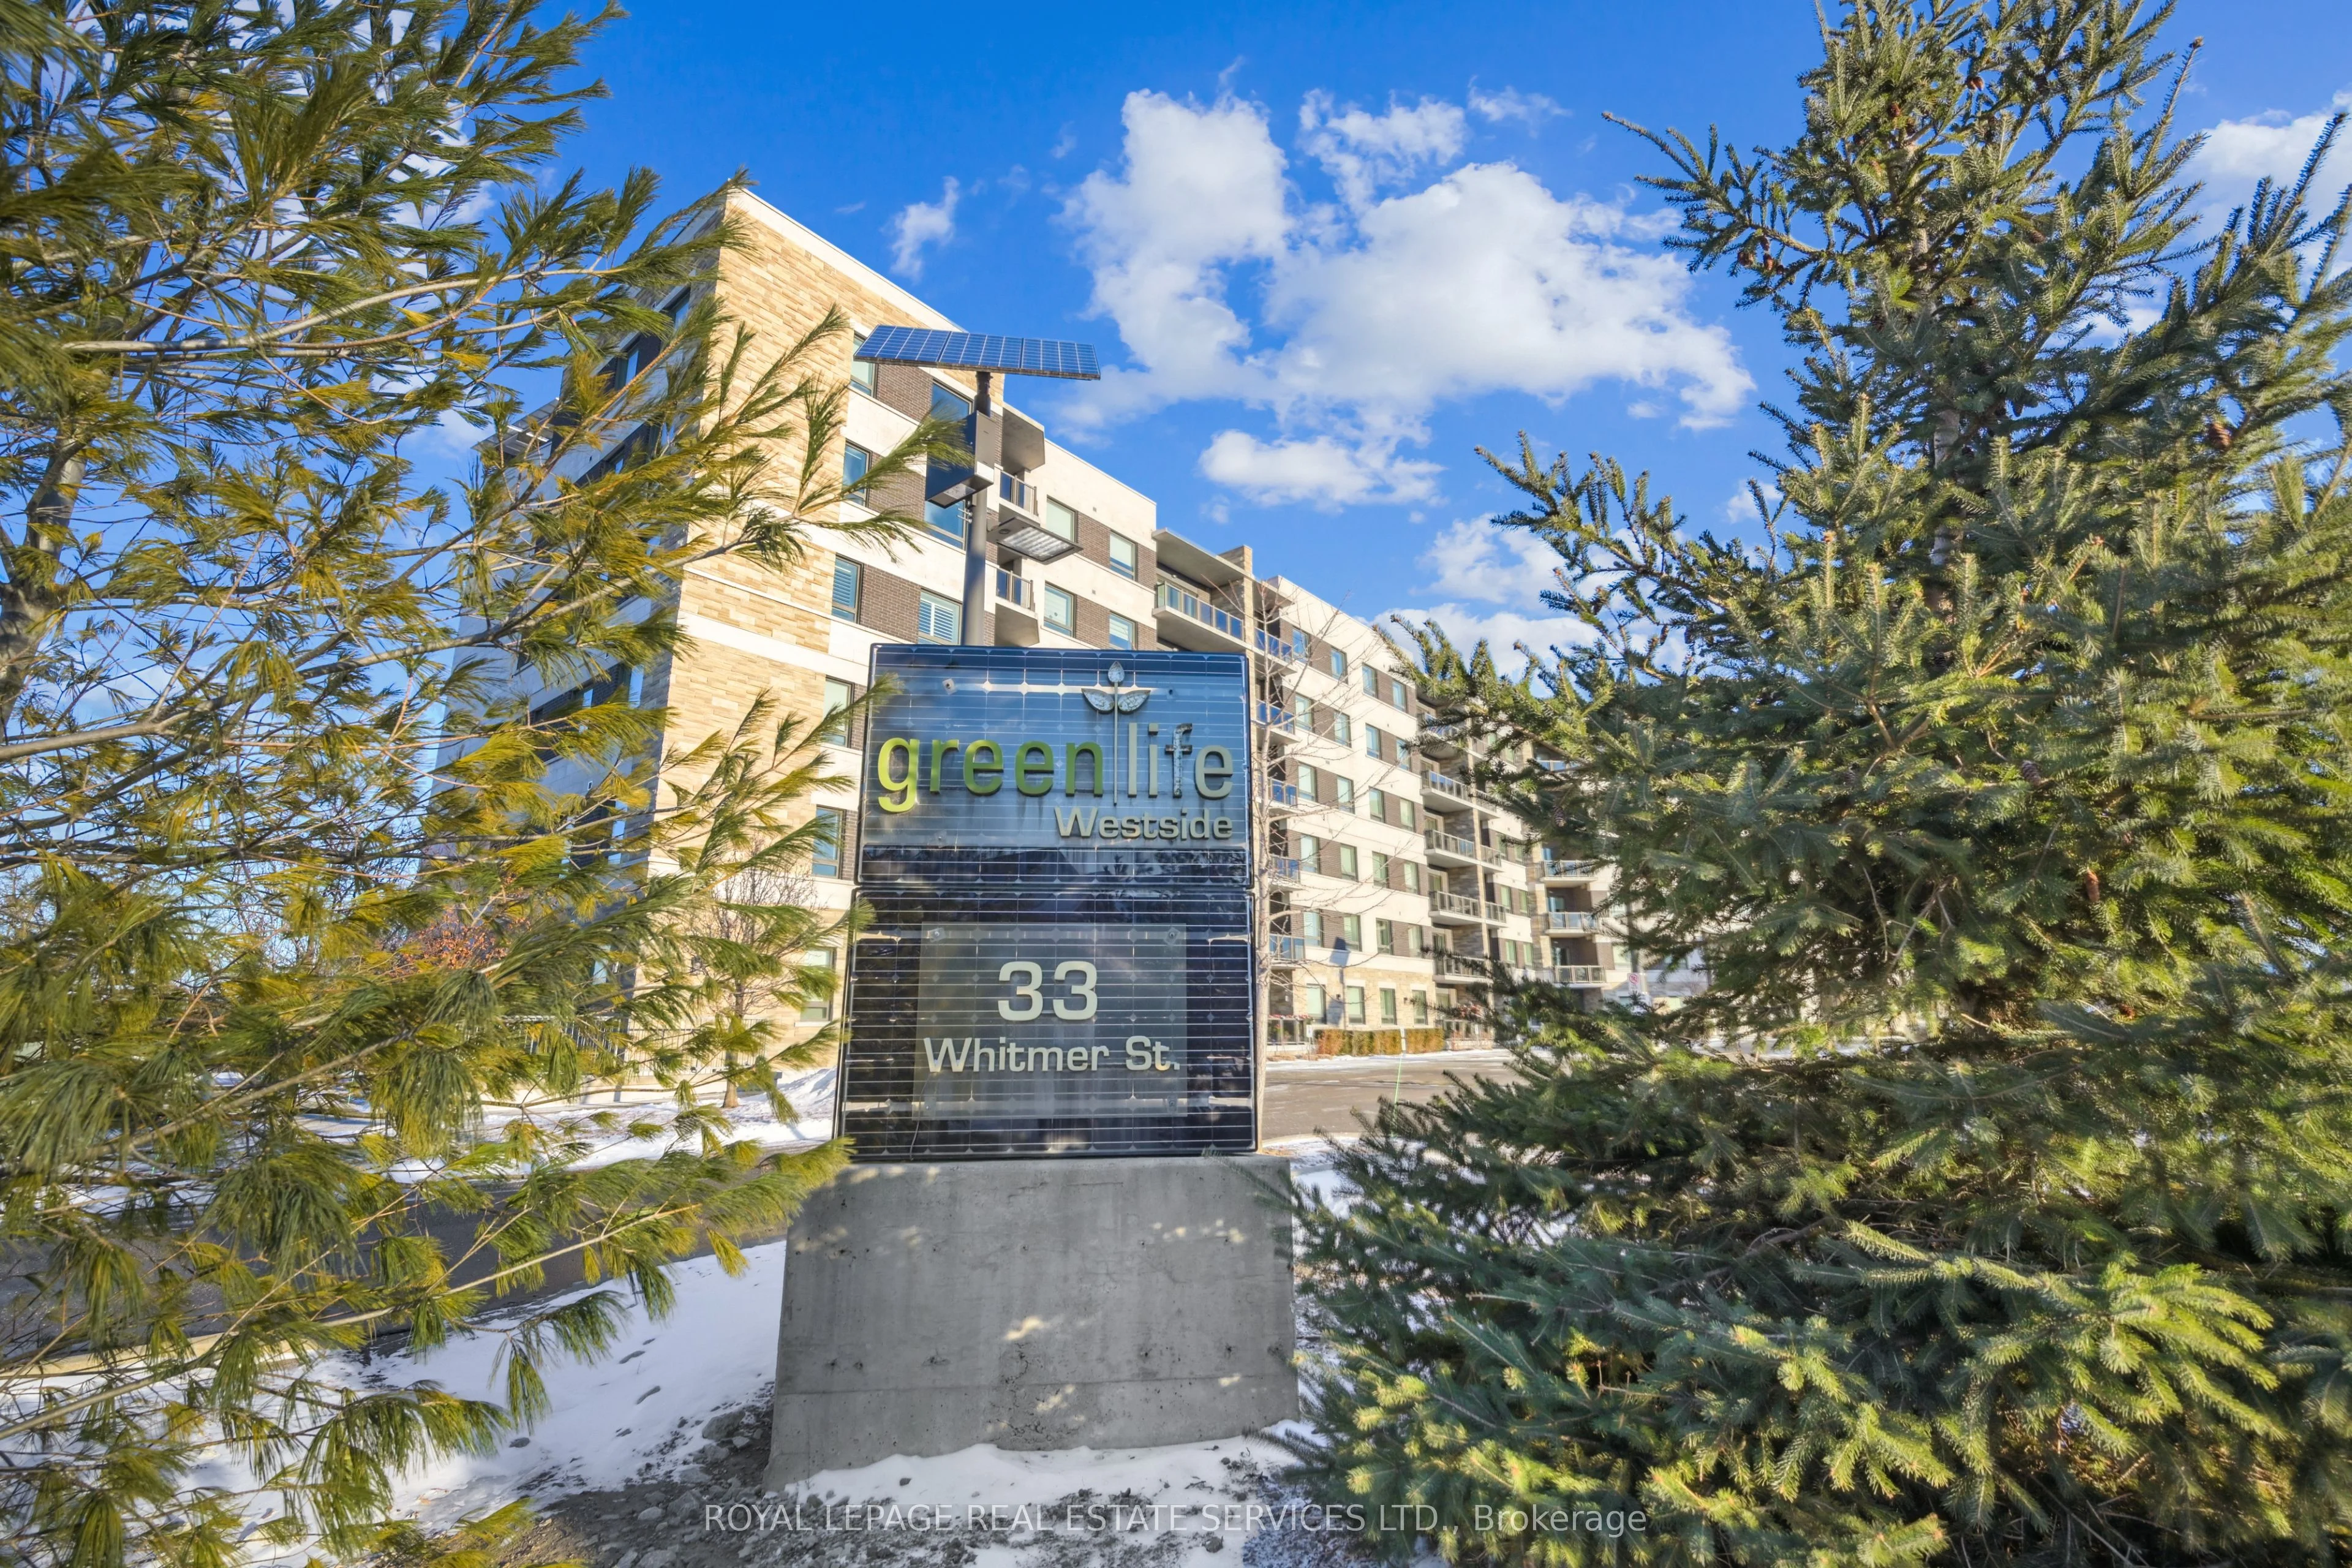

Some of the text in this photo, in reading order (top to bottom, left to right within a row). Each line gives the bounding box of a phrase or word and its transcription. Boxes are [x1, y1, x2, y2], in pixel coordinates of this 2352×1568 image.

[1055, 806, 1233, 840] Westside
[997, 960, 1098, 1022] 33
[923, 1035, 1181, 1073] Whitmer St.
